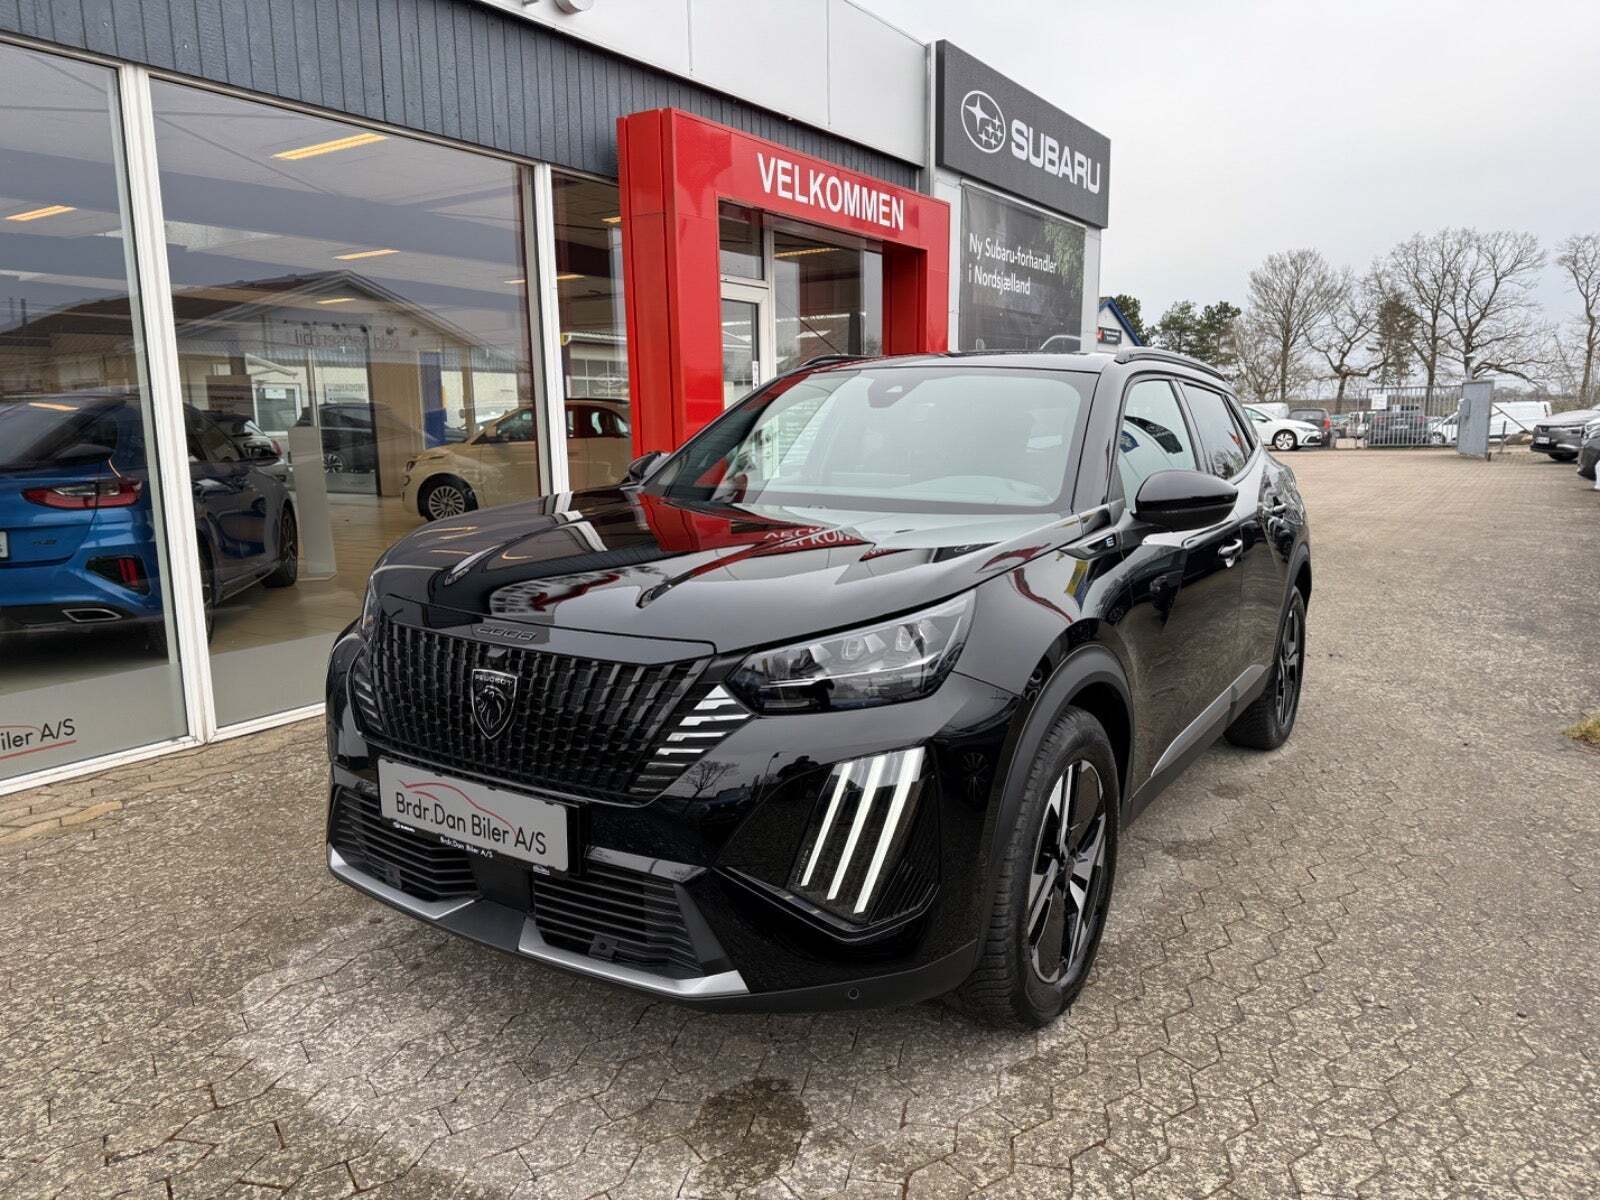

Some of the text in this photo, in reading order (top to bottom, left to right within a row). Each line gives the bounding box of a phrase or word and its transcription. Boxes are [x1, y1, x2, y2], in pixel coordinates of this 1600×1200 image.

[1011, 118, 1100, 194] SUBARU
[757, 152, 904, 232] VELKOMMEN
[968, 263, 1031, 295] i Nordsjælland
[969, 232, 1058, 275] Ny Subaru-forhandler
[40, 718, 75, 742] A/S
[396, 792, 466, 833] Brdr.Dan
[472, 813, 509, 844] Biler
[514, 826, 547, 855] A/S
